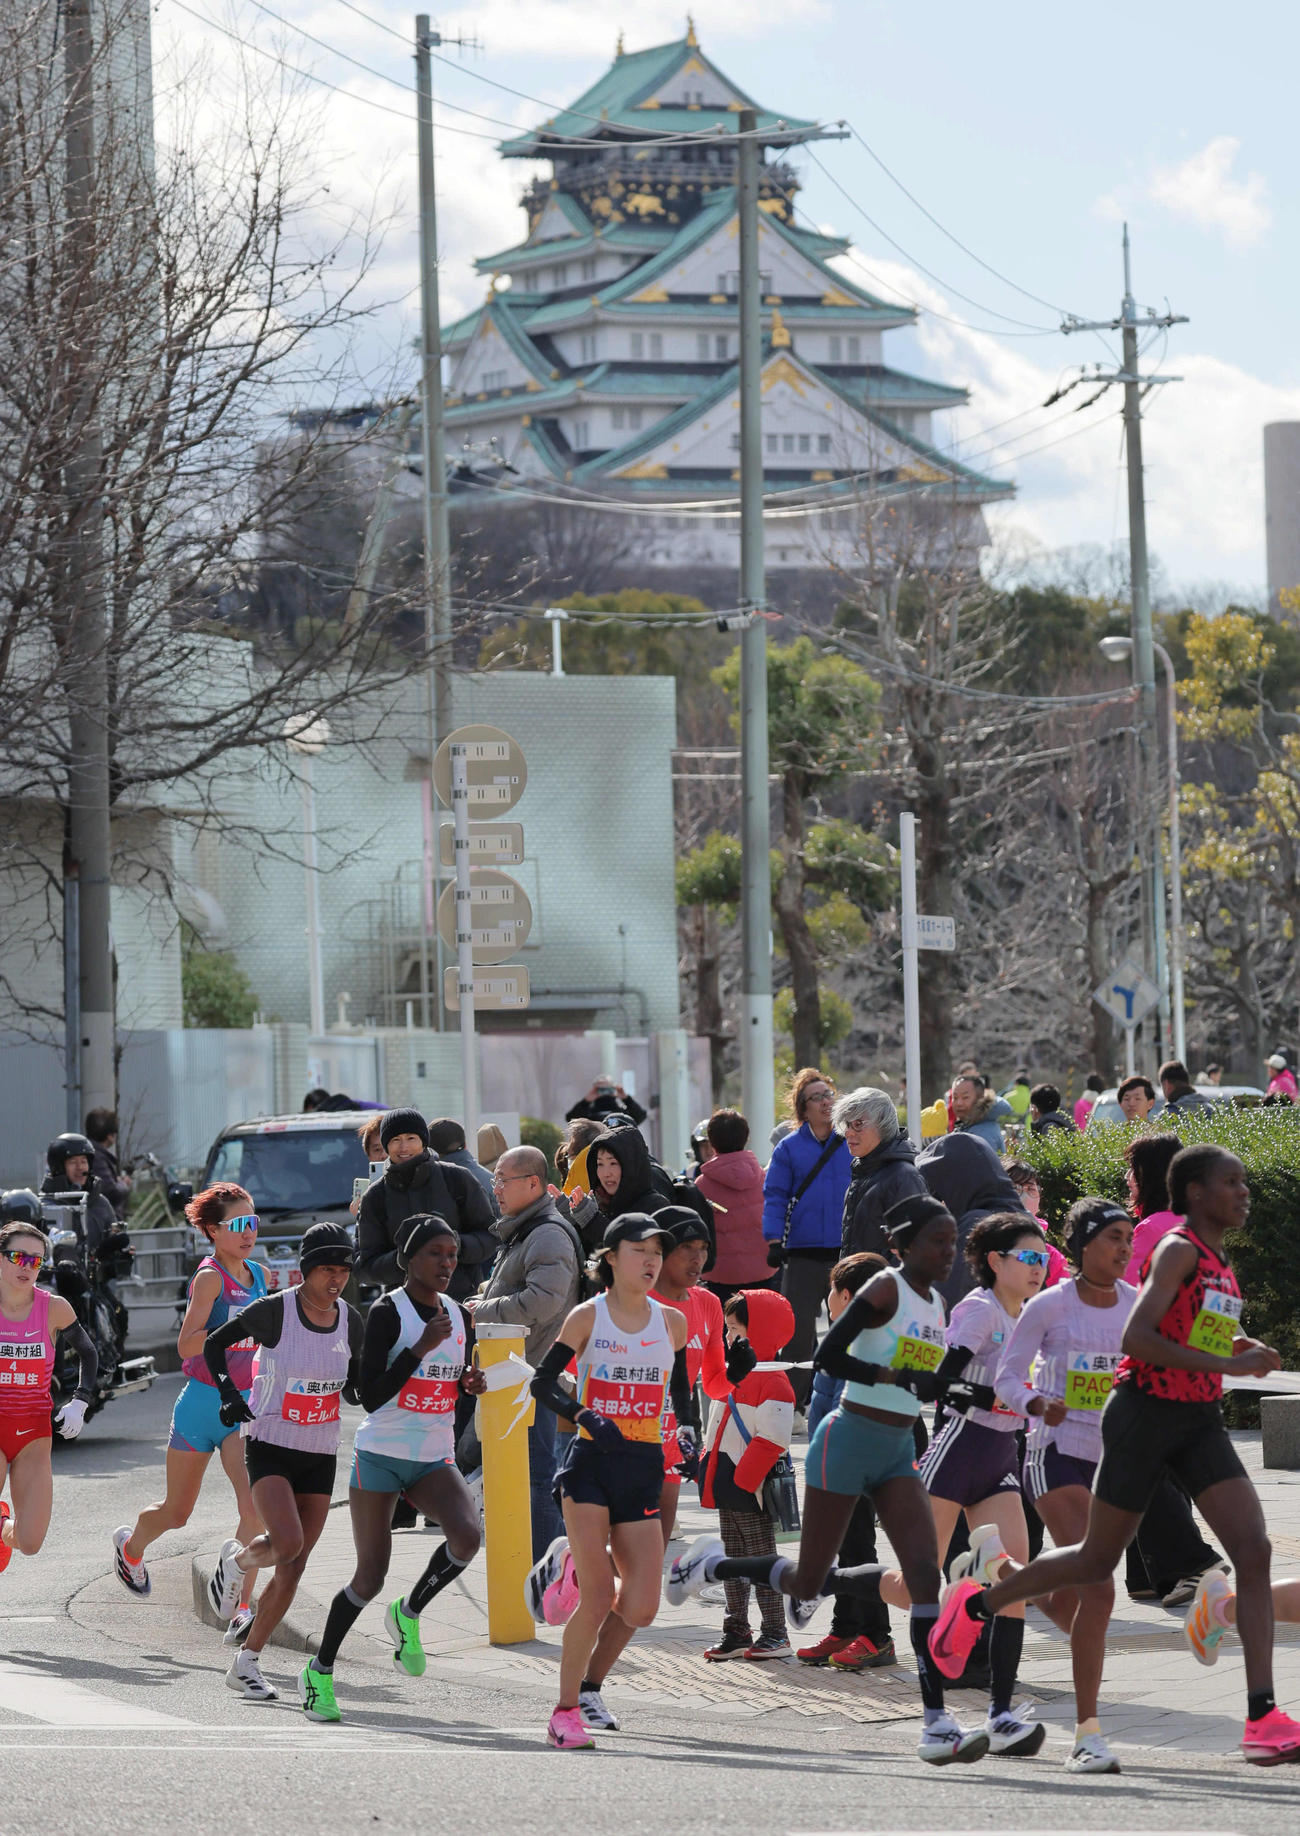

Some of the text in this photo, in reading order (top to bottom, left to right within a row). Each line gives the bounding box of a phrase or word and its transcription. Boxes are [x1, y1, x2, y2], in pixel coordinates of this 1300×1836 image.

[0, 1344, 42, 1358] 奥村組
[9, 1361, 17, 1371] 4
[611, 1366, 659, 1382] 奥村組
[433, 1383, 443, 1396] 2
[619, 1385, 635, 1399] 11
[314, 1398, 323, 1409] 3
[592, 1397, 657, 1417] 矢田みくに
